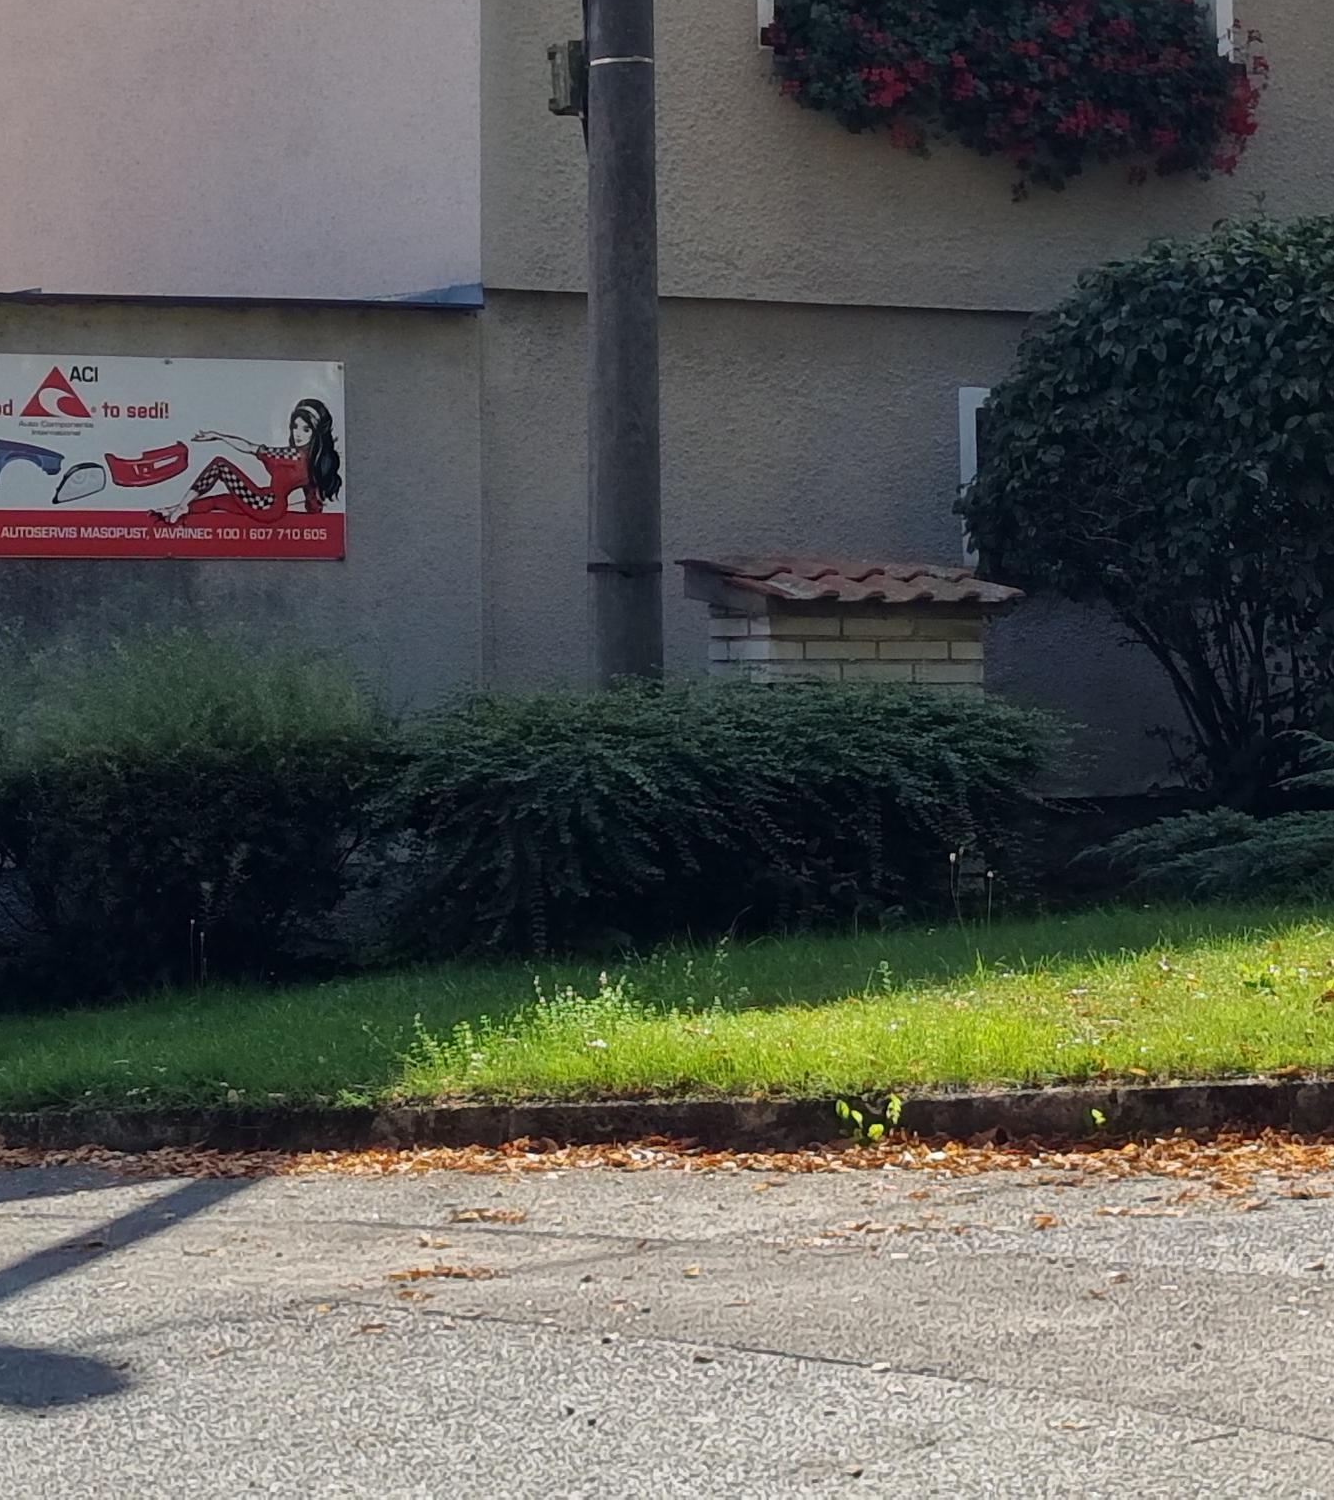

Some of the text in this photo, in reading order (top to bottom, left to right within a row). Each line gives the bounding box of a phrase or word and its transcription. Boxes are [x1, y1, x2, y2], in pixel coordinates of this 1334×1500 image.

[69, 366, 98, 383] ACI
[102, 402, 120, 418] to
[126, 402, 169, 419] sedí!
[0, 526, 77, 538] AUTOSERVIS
[80, 527, 150, 540] MASOPUST,
[153, 524, 213, 539] VAVŘINEC
[216, 528, 240, 540] 100
[249, 529, 273, 540] 607
[277, 529, 300, 540] 710
[303, 529, 328, 540] 605
